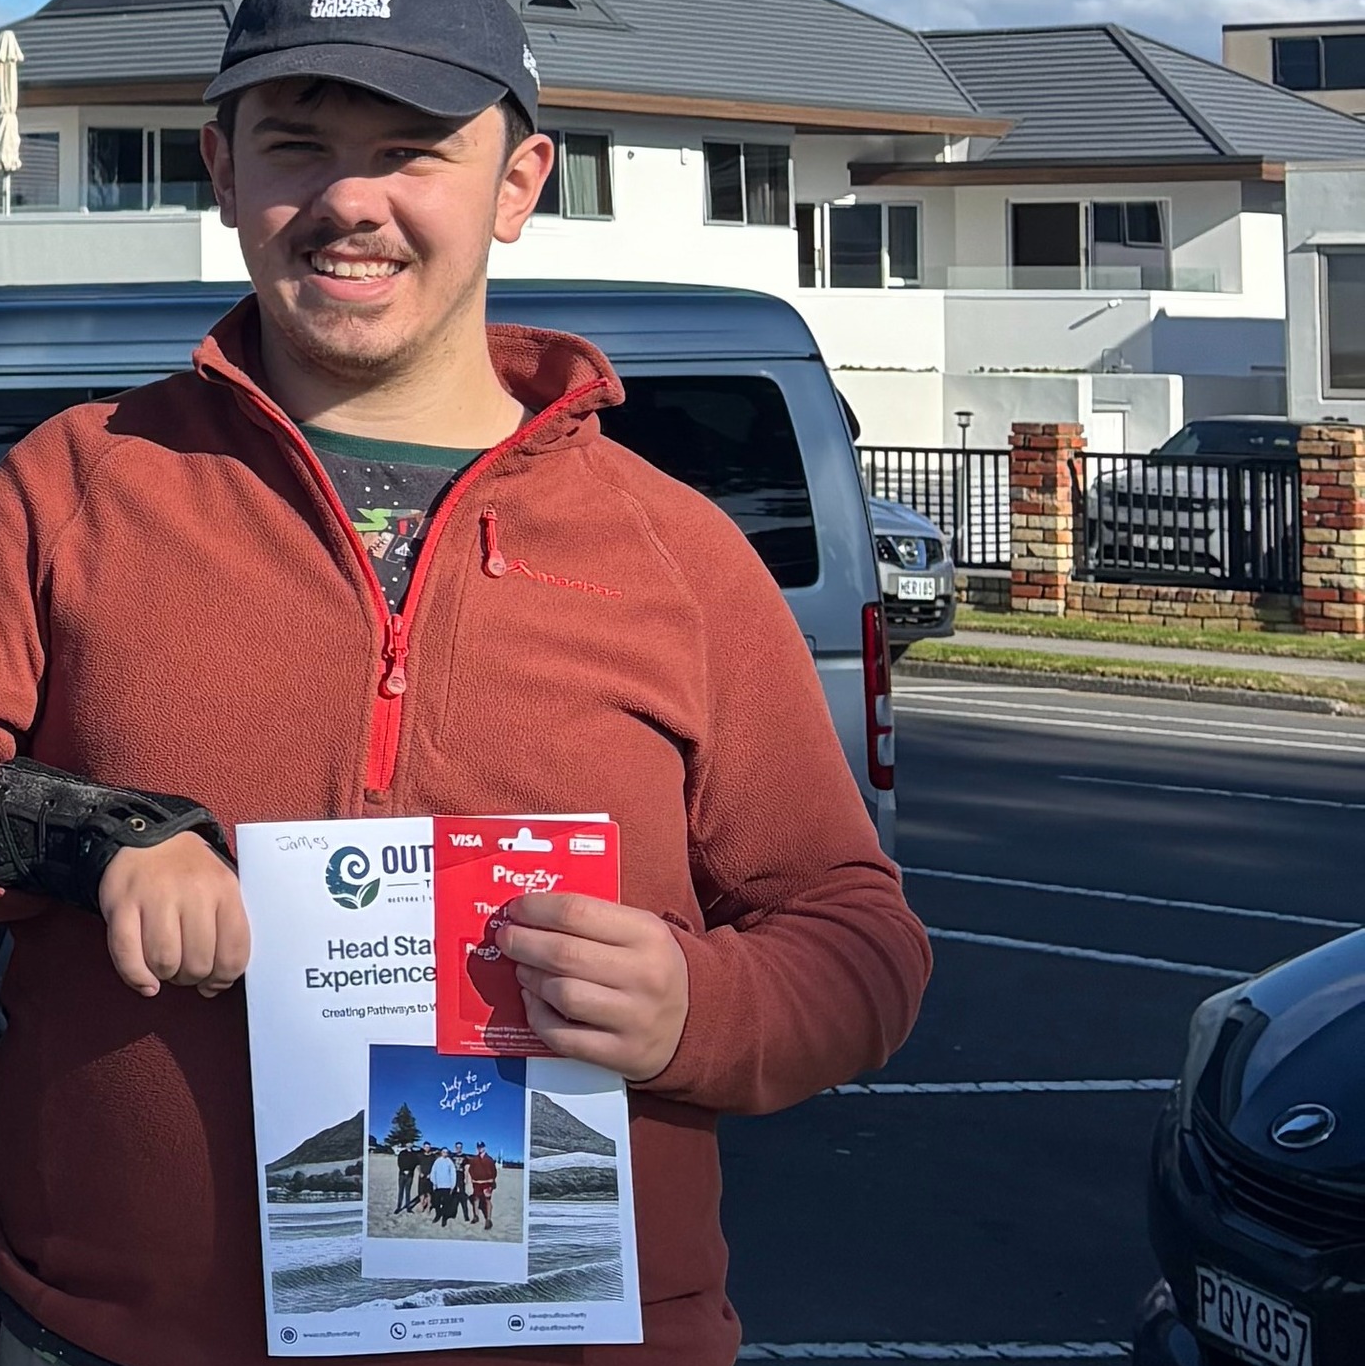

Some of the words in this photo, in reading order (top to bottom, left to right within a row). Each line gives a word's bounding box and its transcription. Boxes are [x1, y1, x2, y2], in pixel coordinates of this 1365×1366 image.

[310, 4, 391, 19] UNICORNS
[448, 833, 483, 849] VISA
[492, 864, 558, 892] Prezzy
[474, 901, 499, 916] The
[327, 936, 389, 961] Head
[394, 934, 433, 957] Sta
[305, 963, 437, 992] Experience
[321, 1006, 366, 1020] Creating
[367, 1003, 416, 1017] Pathways
[417, 1003, 429, 1014] to
[465, 1070, 478, 1084] to
[439, 1082, 492, 1111] September
